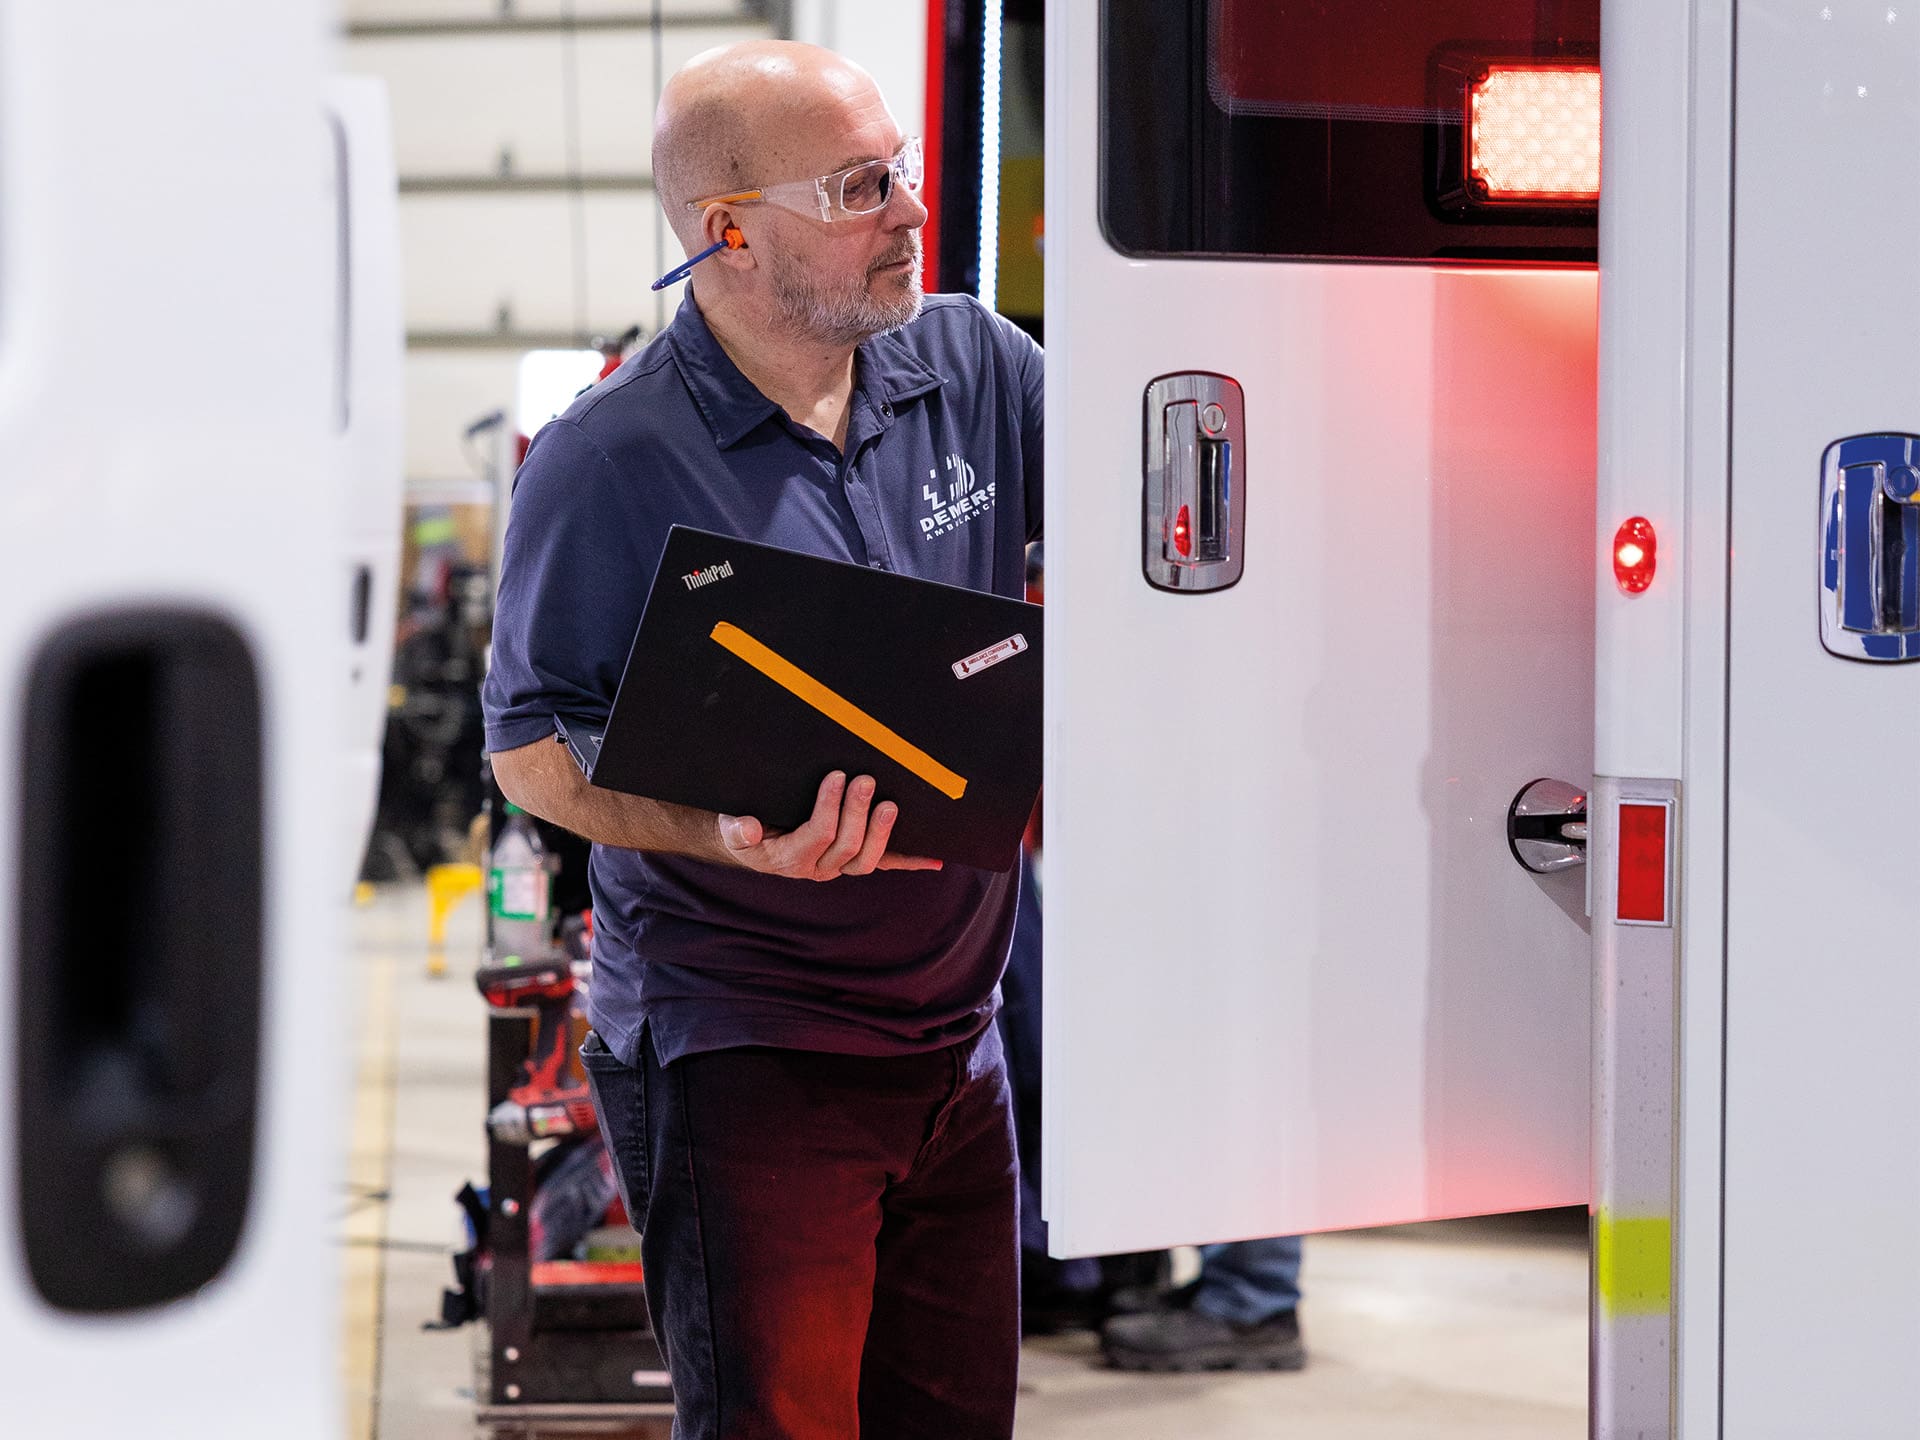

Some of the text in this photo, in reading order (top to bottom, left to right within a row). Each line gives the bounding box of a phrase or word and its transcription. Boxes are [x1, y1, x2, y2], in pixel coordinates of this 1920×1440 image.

[920, 482, 996, 533] DEMERS
[926, 500, 996, 541] AMBLANC
[681, 560, 734, 591] ThinkPad
